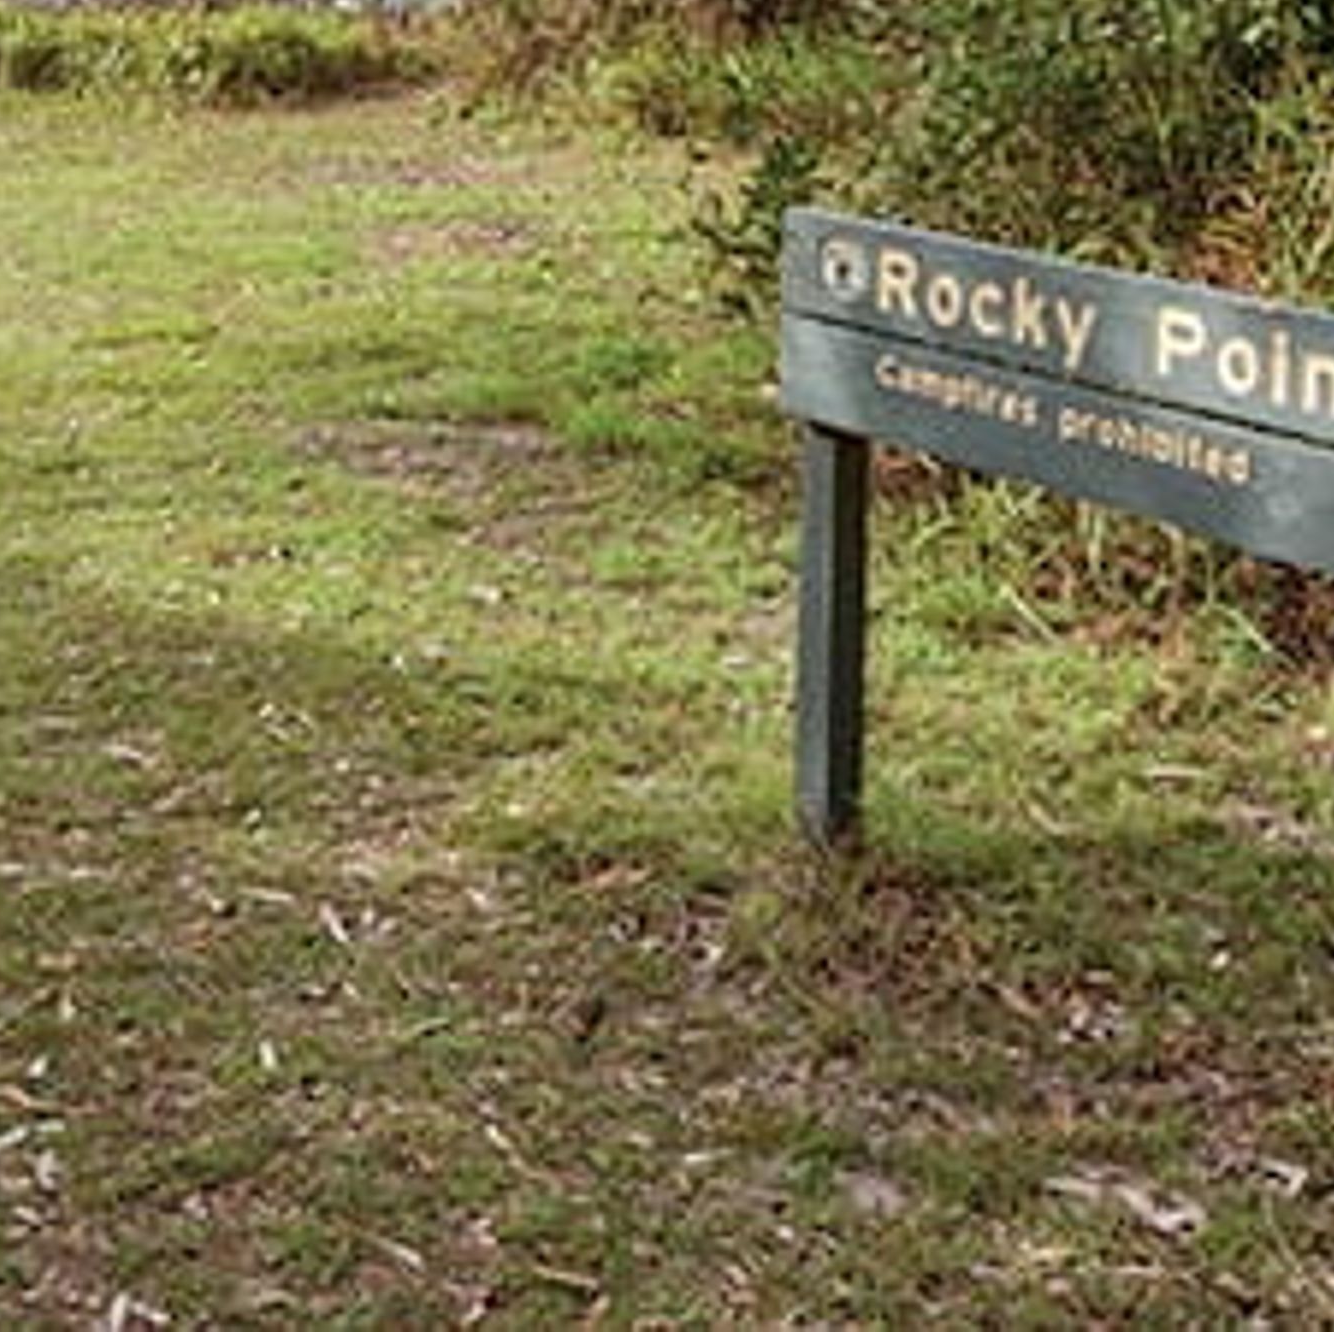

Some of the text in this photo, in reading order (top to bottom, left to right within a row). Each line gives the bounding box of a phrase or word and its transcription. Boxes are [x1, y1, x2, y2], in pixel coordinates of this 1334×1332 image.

[875, 248, 1097, 371] Rocky
[873, 354, 1254, 485] Campfires prohibited
